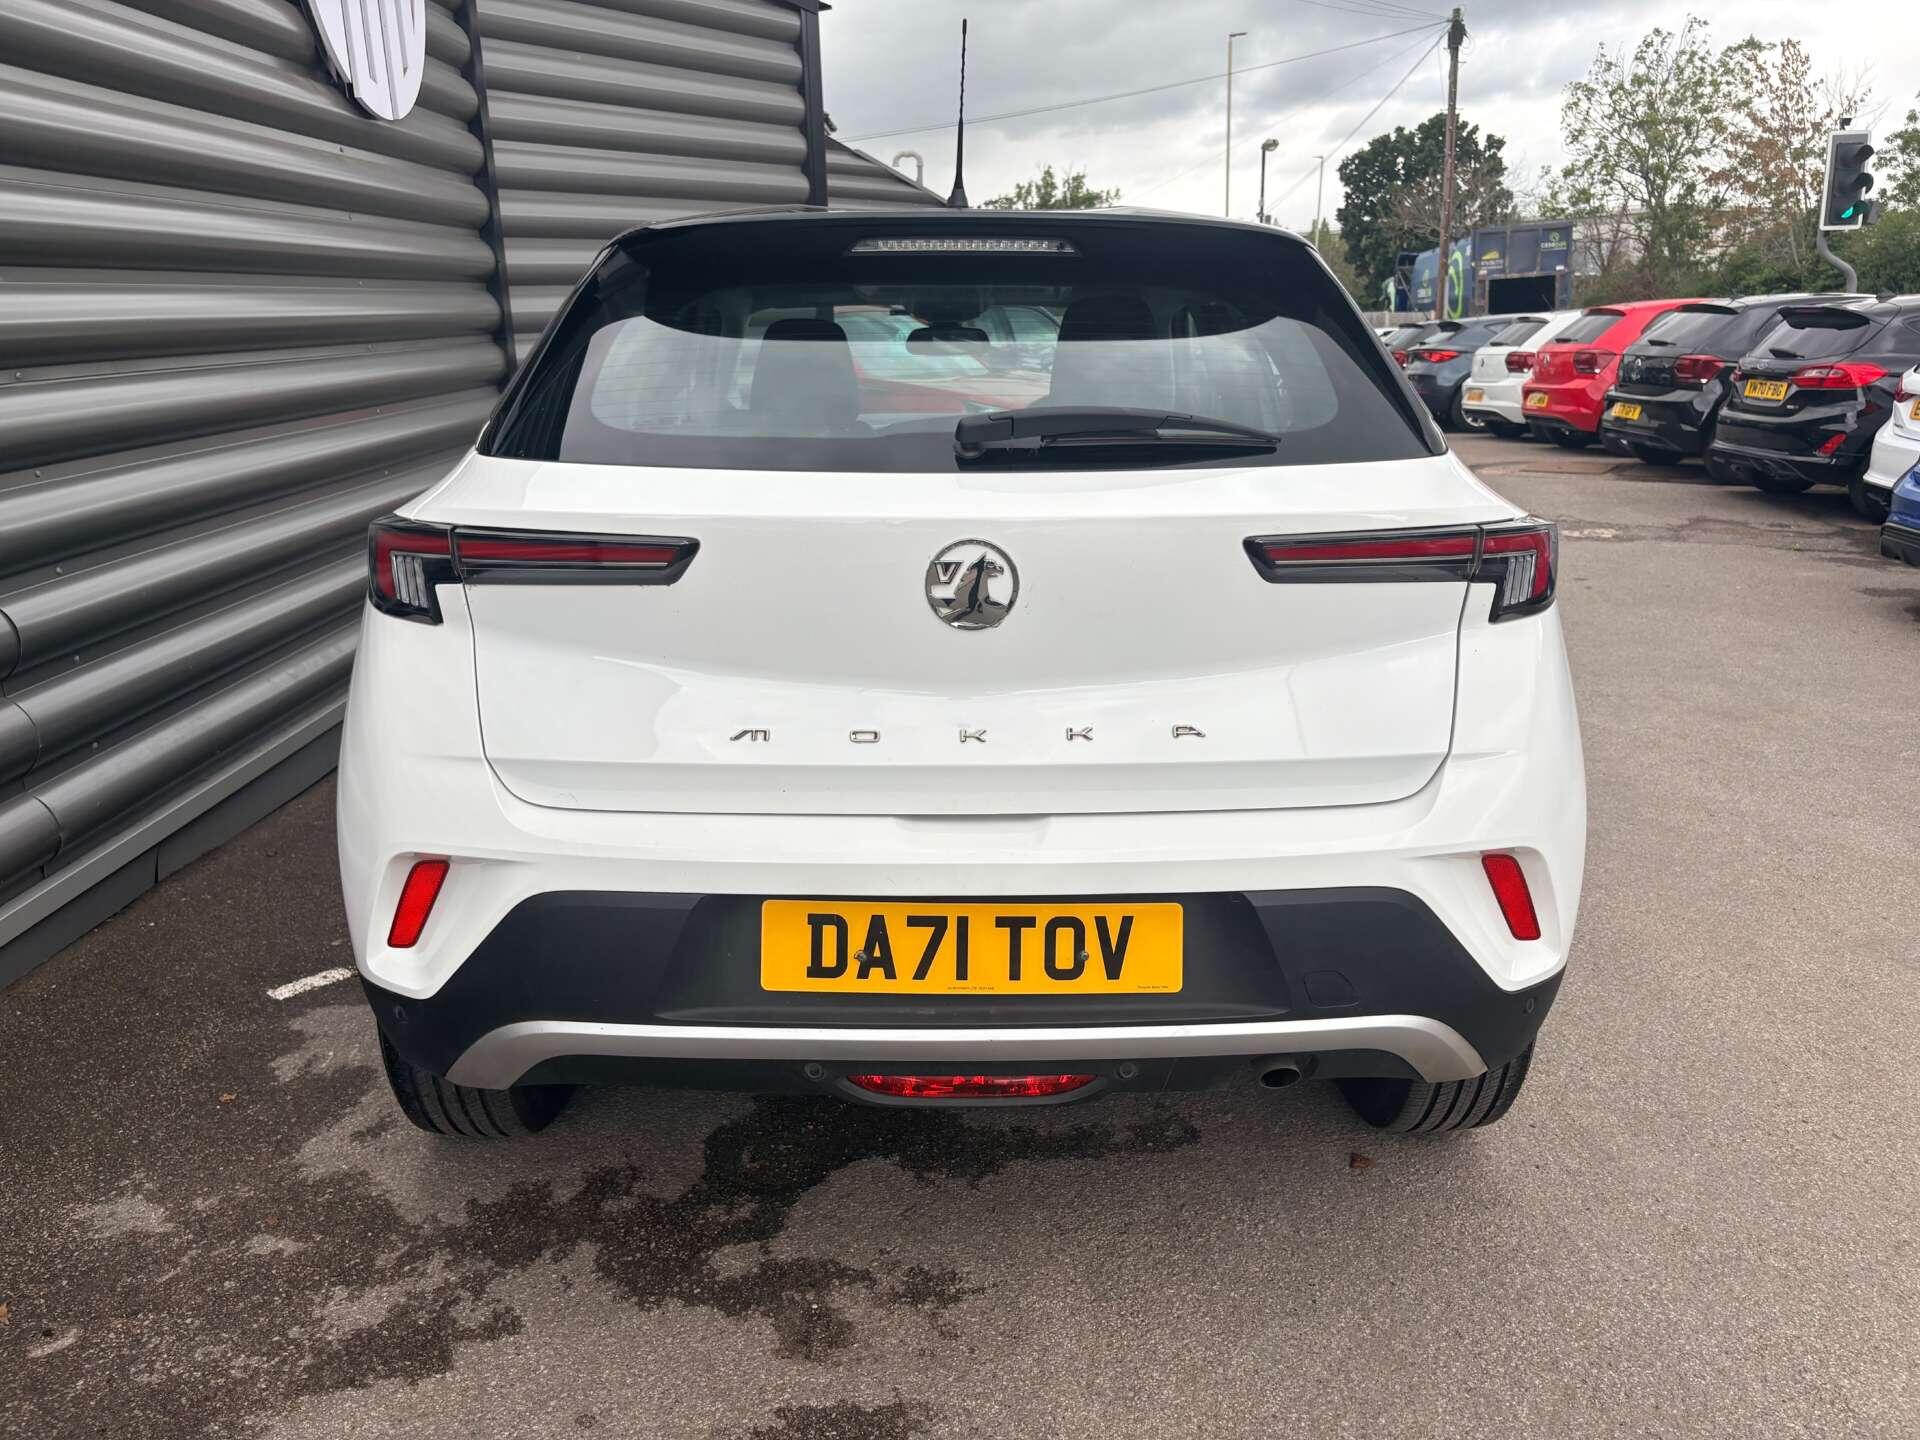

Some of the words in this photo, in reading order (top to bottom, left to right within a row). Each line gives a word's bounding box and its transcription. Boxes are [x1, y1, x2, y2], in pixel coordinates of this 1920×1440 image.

[729, 724, 1206, 744] MOKKA
[806, 913, 969, 981] DA71
[994, 915, 1134, 981] TOV
